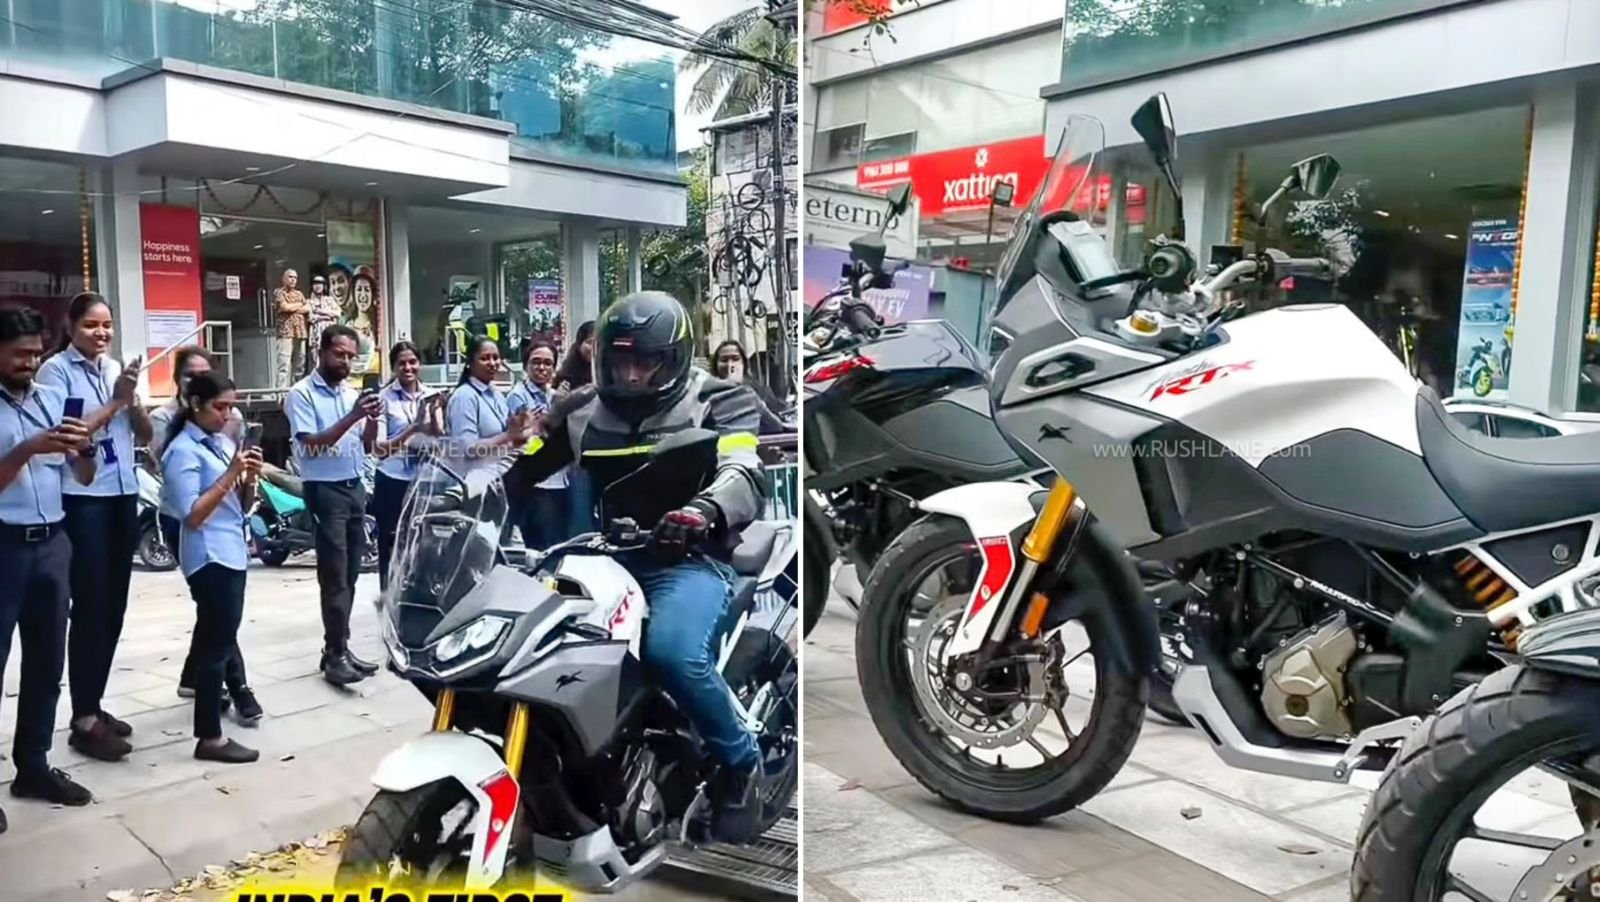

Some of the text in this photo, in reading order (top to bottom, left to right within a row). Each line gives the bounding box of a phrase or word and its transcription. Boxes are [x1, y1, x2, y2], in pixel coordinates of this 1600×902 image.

[143, 240, 190, 252] Happiness
[144, 252, 192, 263] starts here
[1149, 360, 1257, 402] RTX
